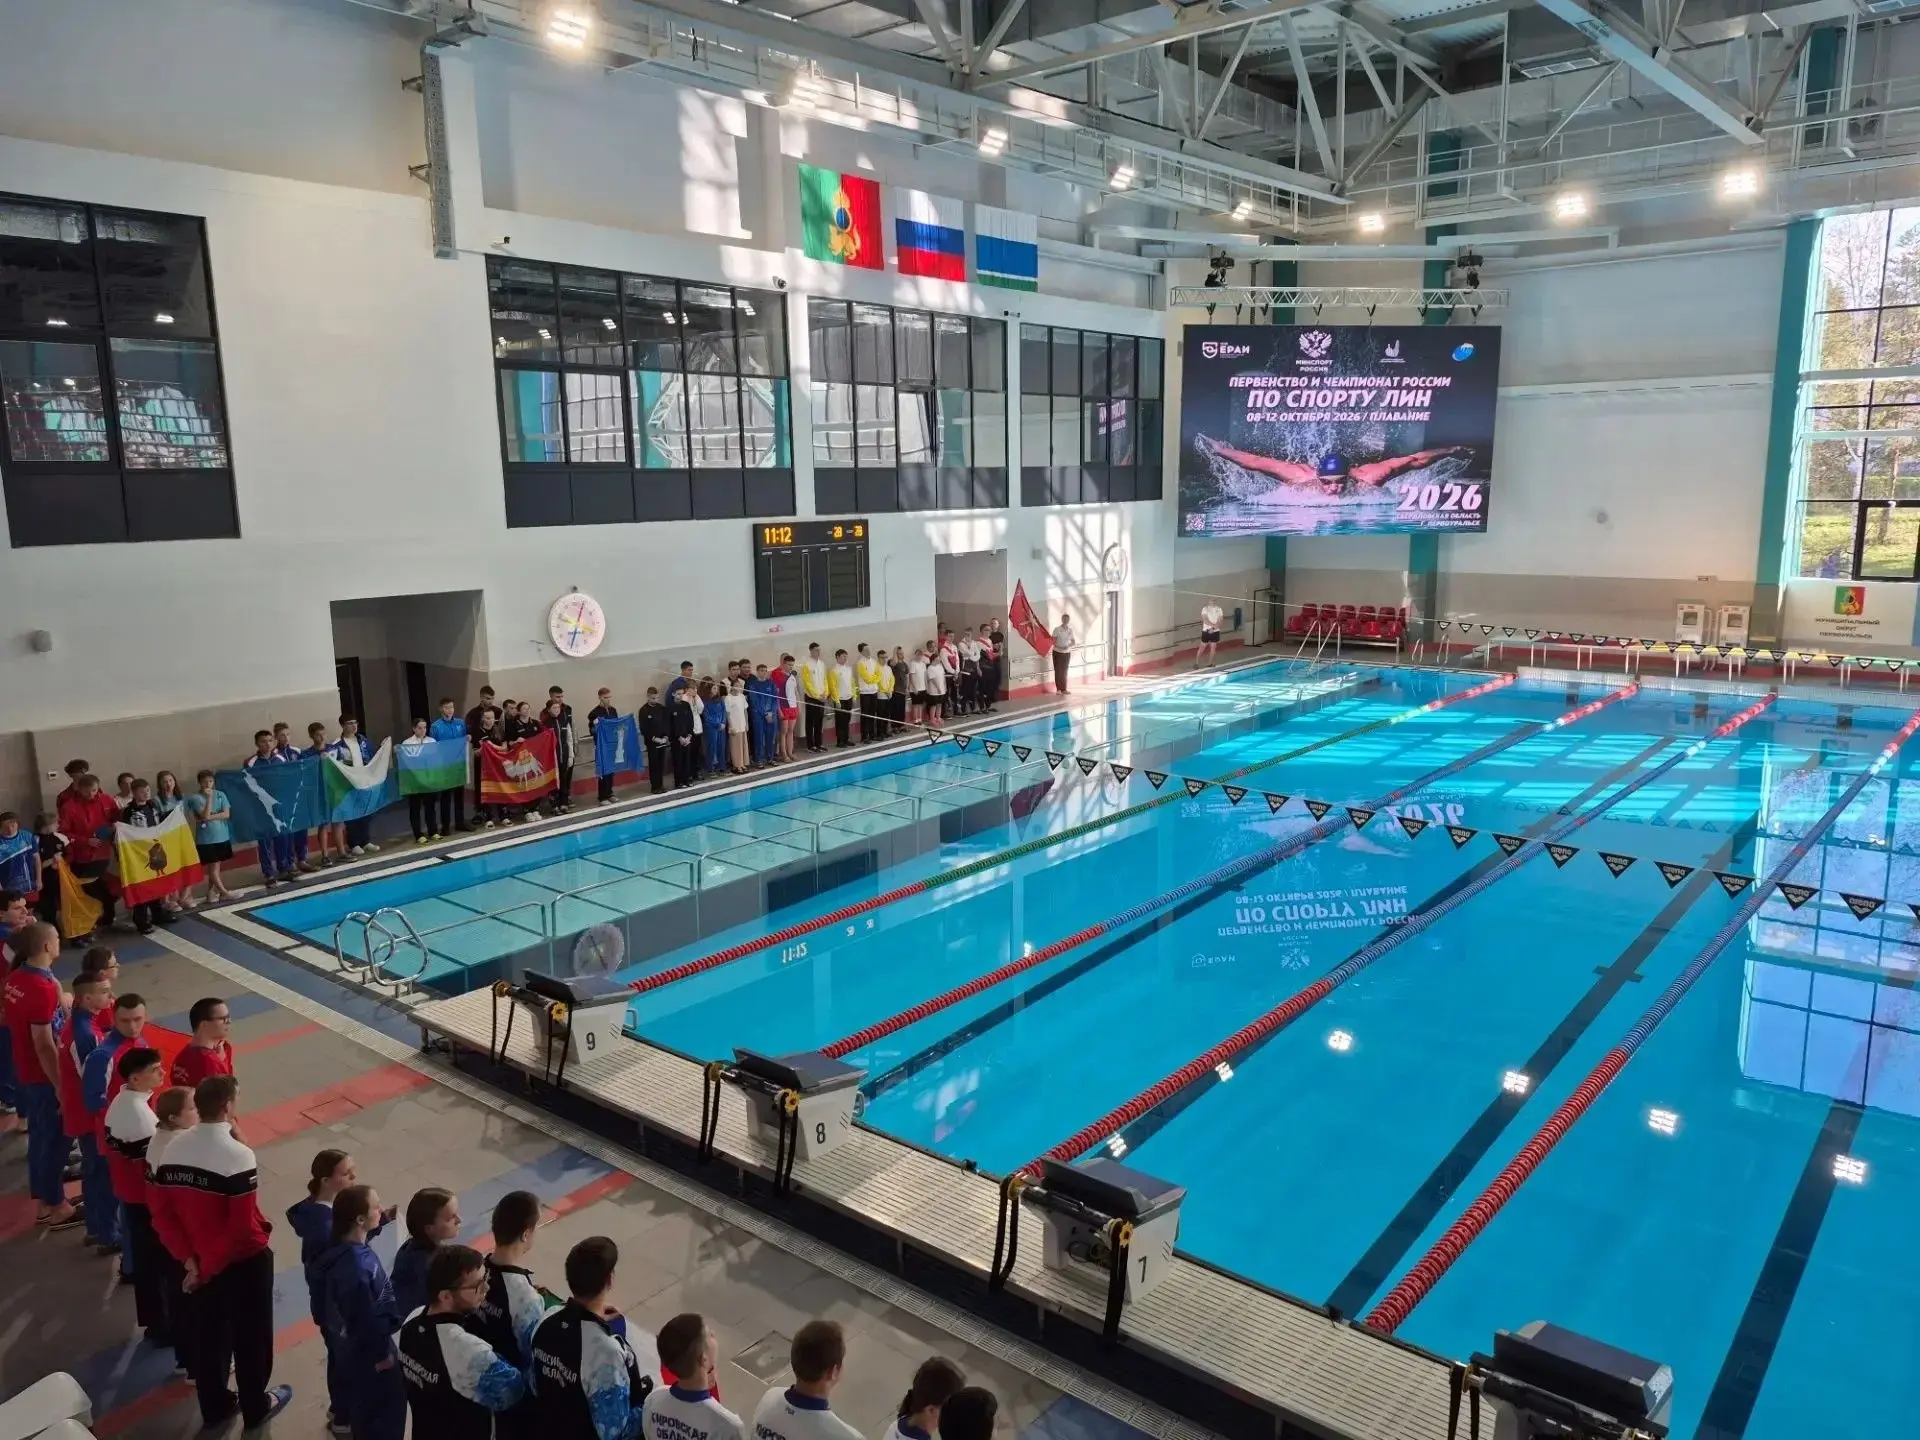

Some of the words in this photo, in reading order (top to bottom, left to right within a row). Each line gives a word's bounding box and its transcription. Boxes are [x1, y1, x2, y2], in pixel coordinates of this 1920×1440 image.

[1229, 376, 1308, 387] ПЕРВЕНСТВО
[1311, 377, 1320, 387] И
[1324, 376, 1400, 387] ЧЕМПИОНАТ
[1402, 376, 1452, 387] РОССИИ
[1247, 390, 1280, 407] ПО
[1286, 390, 1378, 407] СПОРТУ
[1380, 390, 1432, 407] ЛИН
[1246, 412, 1277, 422] 08-12
[1280, 412, 1331, 421] ОКТЯБРЯ
[1332, 412, 1360, 421] 2026
[1369, 411, 1431, 421] ПЛАВАНИЕ
[1396, 483, 1482, 510] 2026
[764, 527, 792, 544] 11:12
[1606, 855, 1629, 865] arena
[1662, 865, 1686, 875] arena
[1722, 876, 1746, 885] arena
[1784, 887, 1810, 897] arena
[1849, 897, 1876, 908] arena
[586, 1032, 596, 1051] 9
[815, 1122, 826, 1144] 8
[1138, 1256, 1147, 1283] 7
